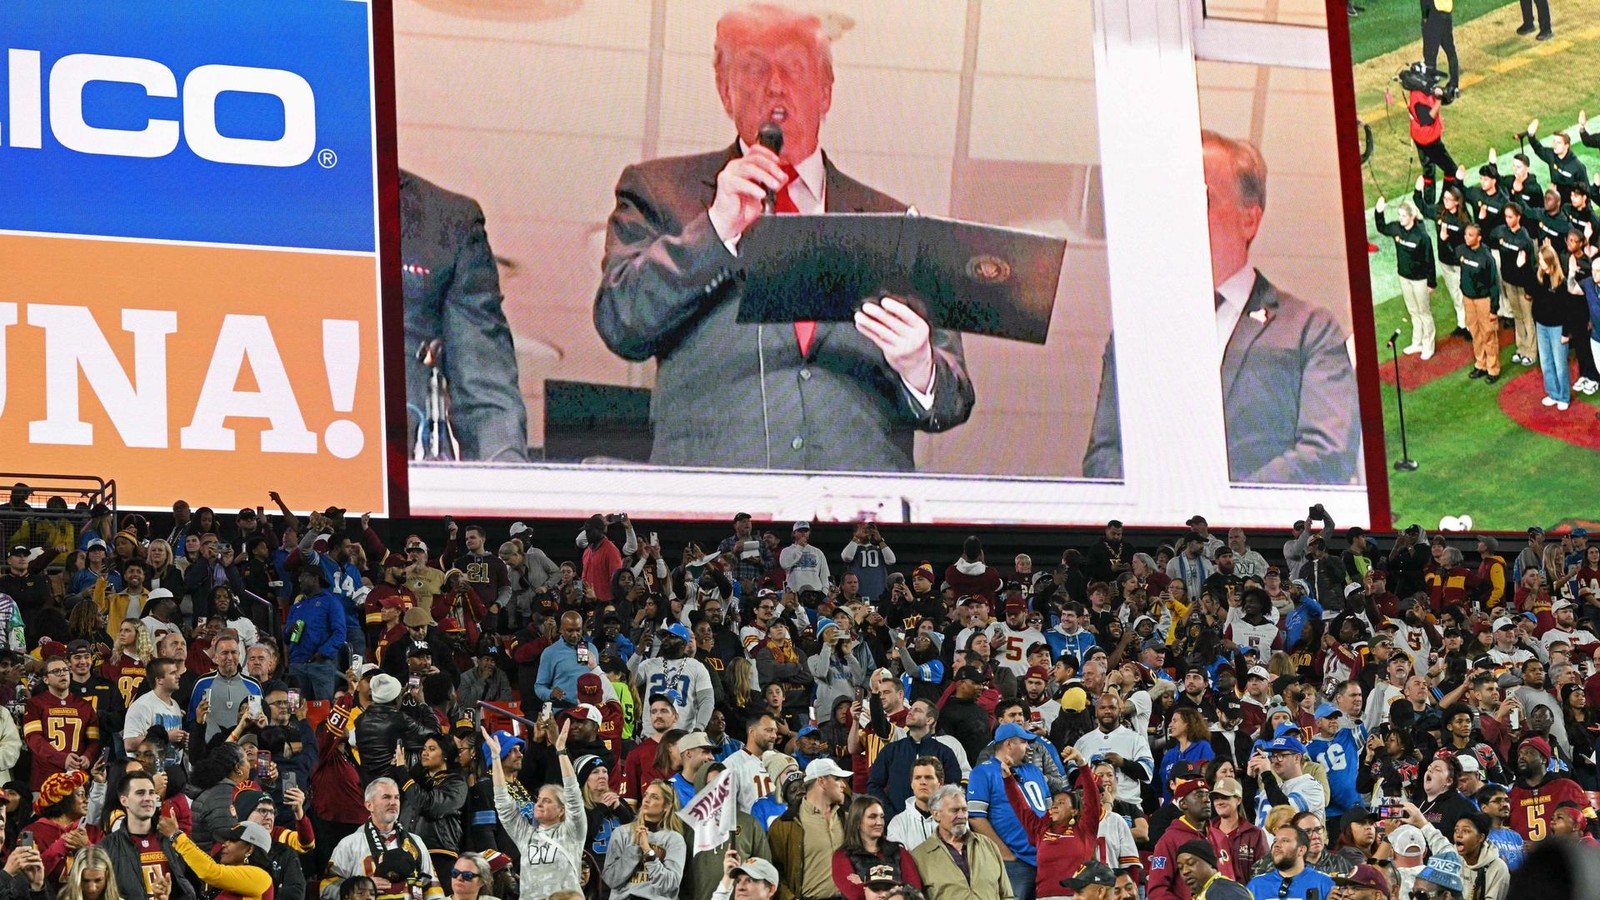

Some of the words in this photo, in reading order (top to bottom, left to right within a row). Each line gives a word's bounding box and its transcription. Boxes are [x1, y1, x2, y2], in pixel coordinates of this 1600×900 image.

[0, 48, 316, 168] ICO
[0, 301, 365, 459] NA!
[859, 549, 880, 568] 10
[333, 571, 355, 597] 14
[466, 562, 490, 584] 21
[1005, 636, 1024, 661] 5
[650, 673, 691, 707] 20
[331, 712, 349, 729] 61
[624, 702, 634, 724] 5
[47, 716, 83, 753] 57
[1018, 781, 1047, 812] 0
[1526, 803, 1547, 842] 5
